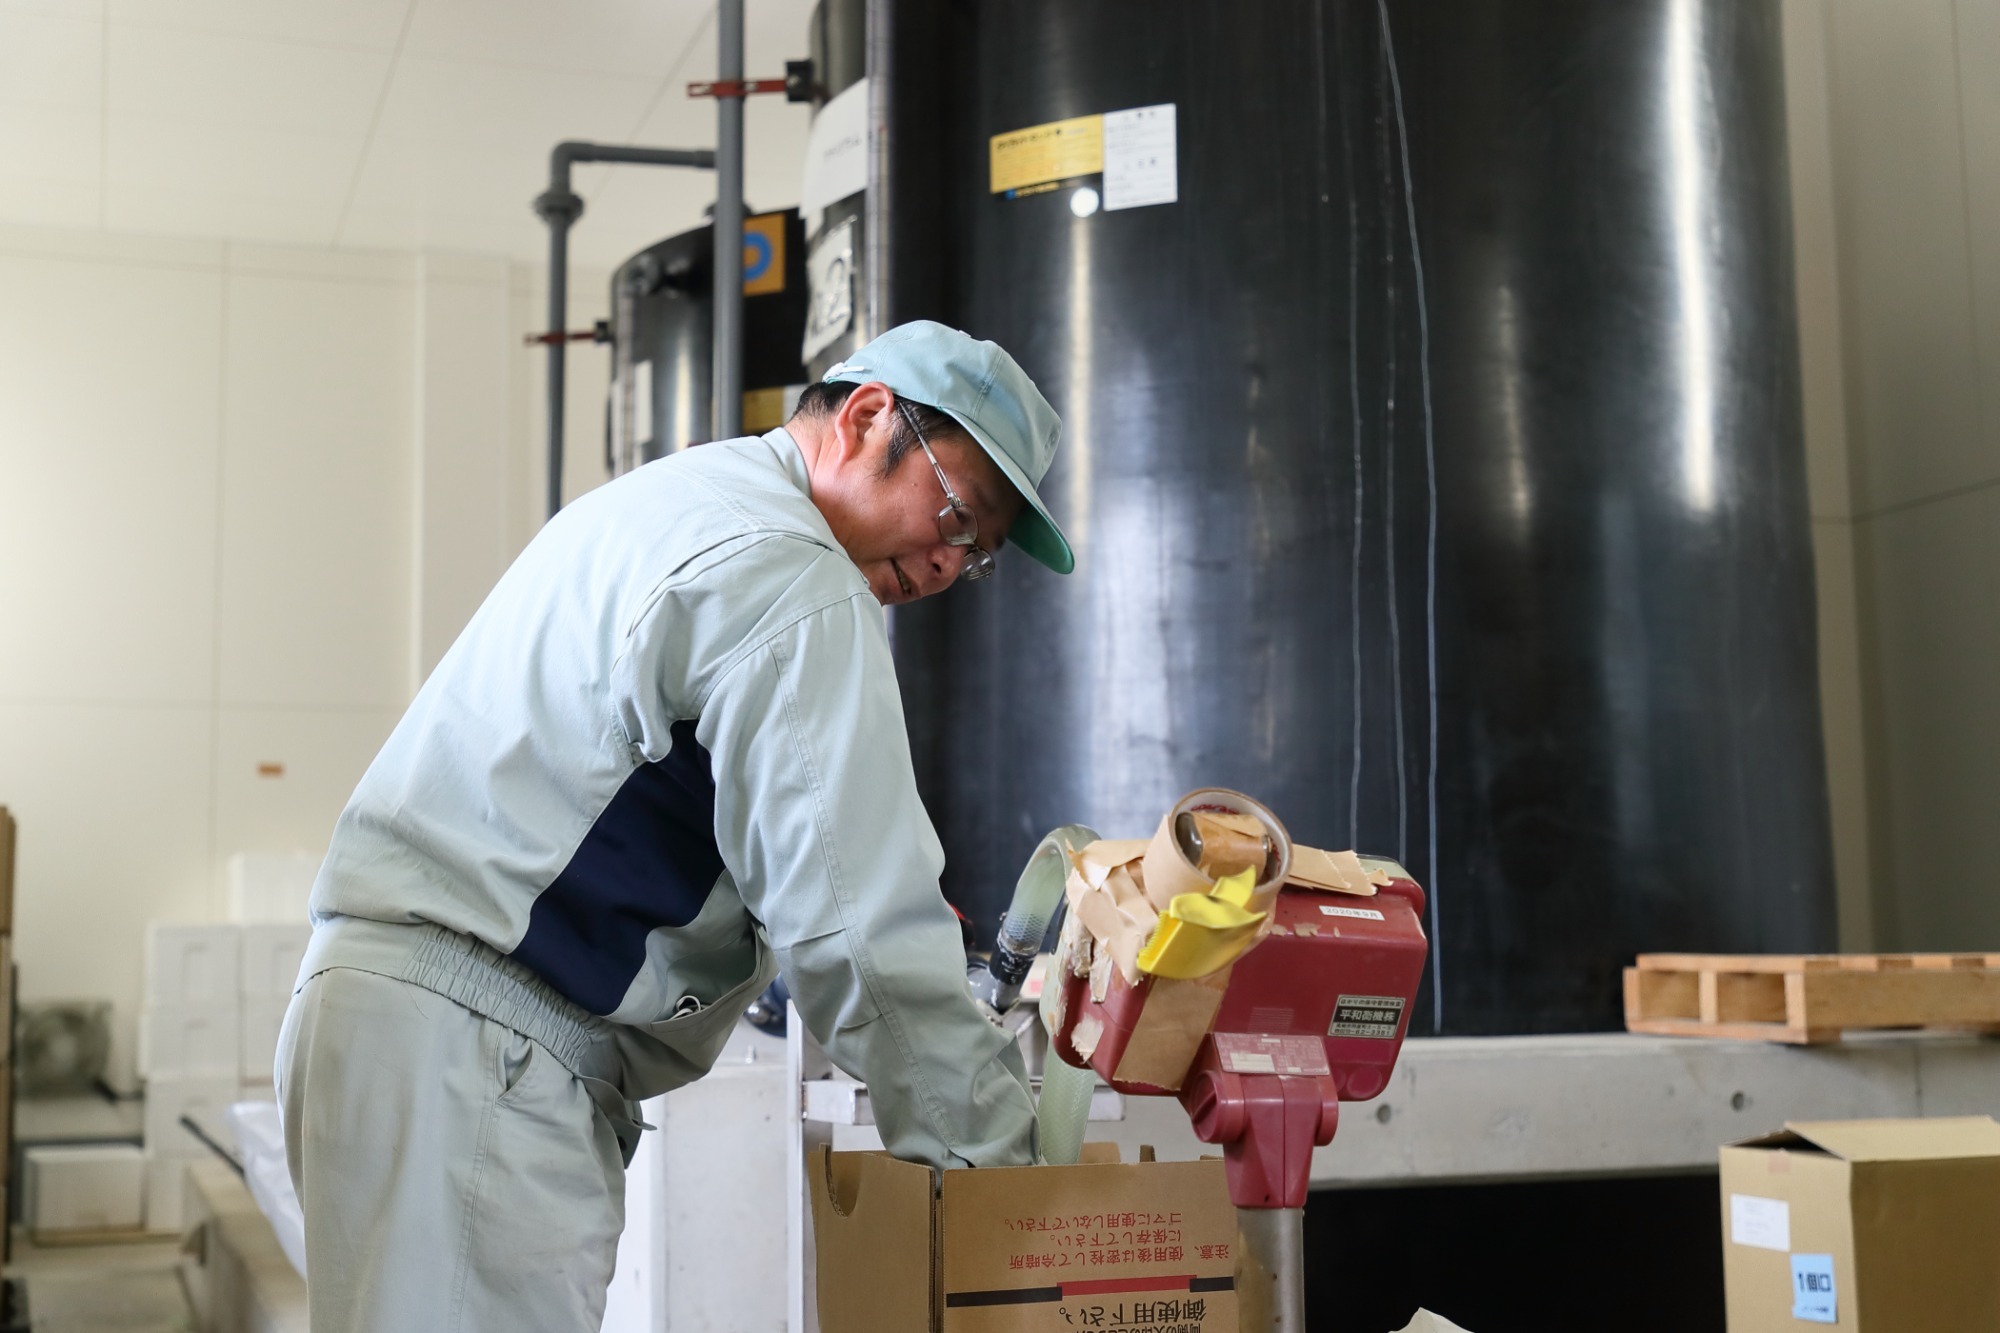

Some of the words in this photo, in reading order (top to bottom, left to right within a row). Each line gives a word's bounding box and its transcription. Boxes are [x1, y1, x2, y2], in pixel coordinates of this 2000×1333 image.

[1004, 1212, 1182, 1232] ゴマに使用しないで下さい。
[1050, 1229, 1182, 1247] に保存して下さい。
[1009, 1246, 1184, 1270] 使用後は密栓して冷暗所
[1059, 1298, 1207, 1326] 御使用下さい。
